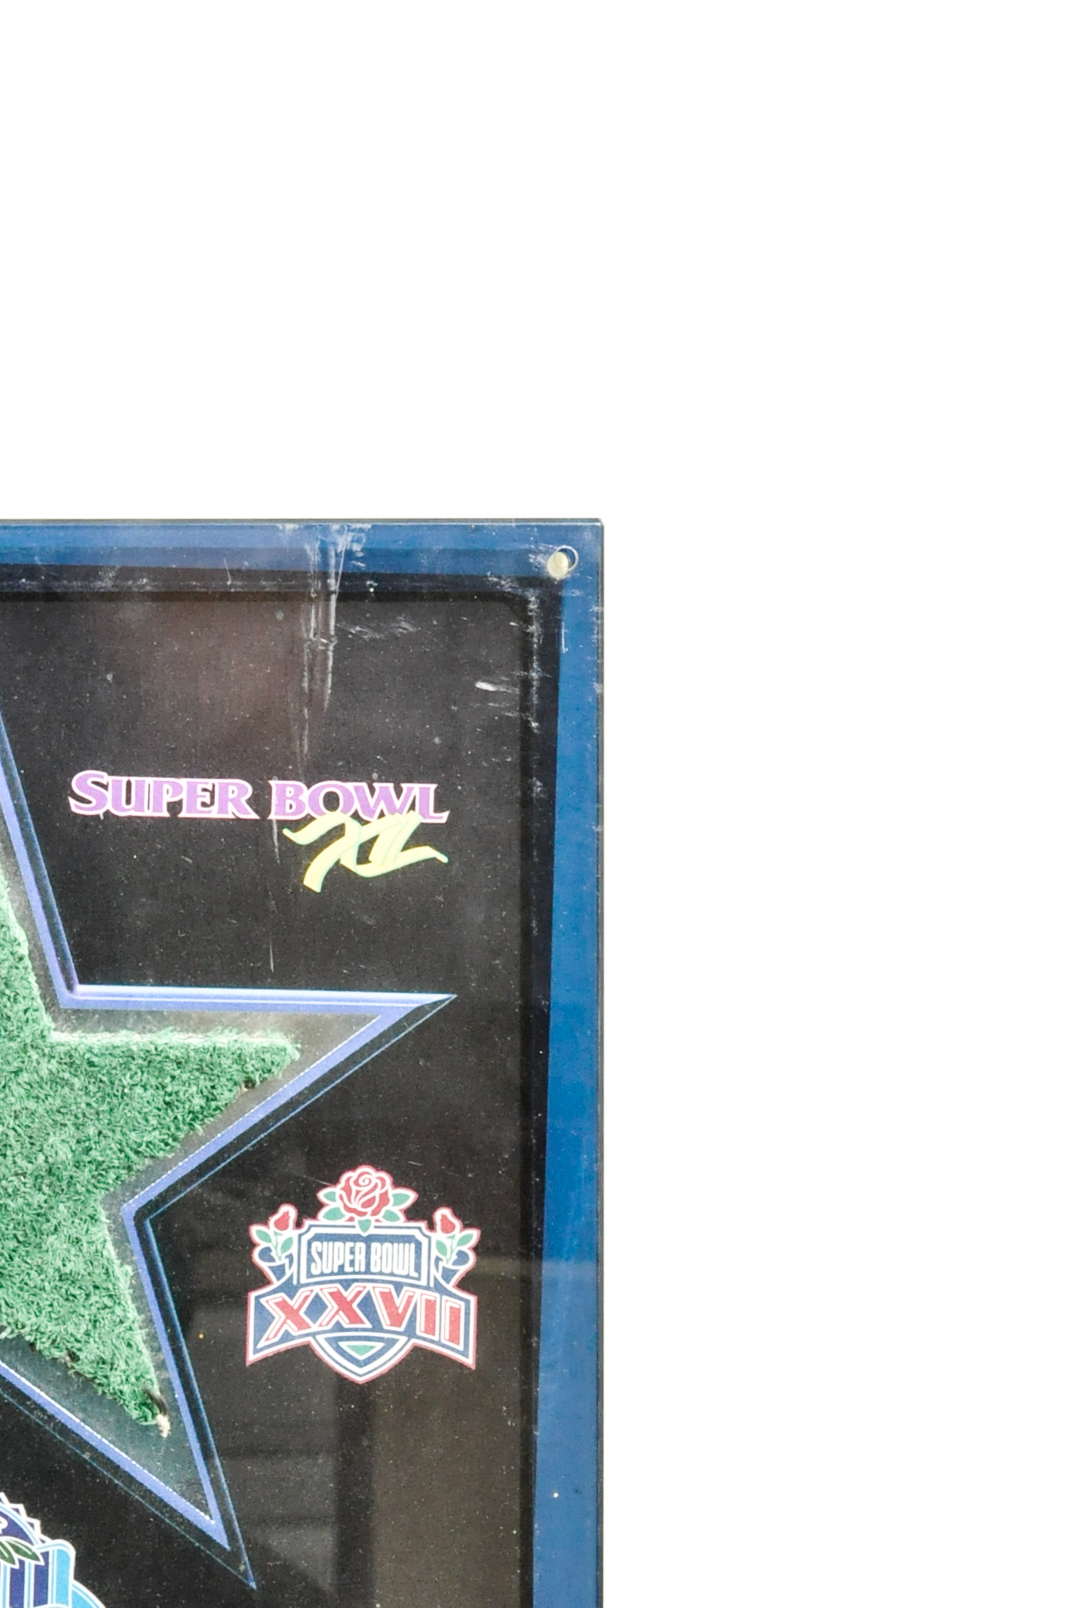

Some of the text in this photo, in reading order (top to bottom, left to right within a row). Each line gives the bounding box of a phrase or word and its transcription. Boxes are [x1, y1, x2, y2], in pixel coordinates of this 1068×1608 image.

[68, 770, 449, 824] SUPER BOWL
[310, 1241, 419, 1277] SUPER BOWL
[257, 1282, 465, 1350] XXVII
